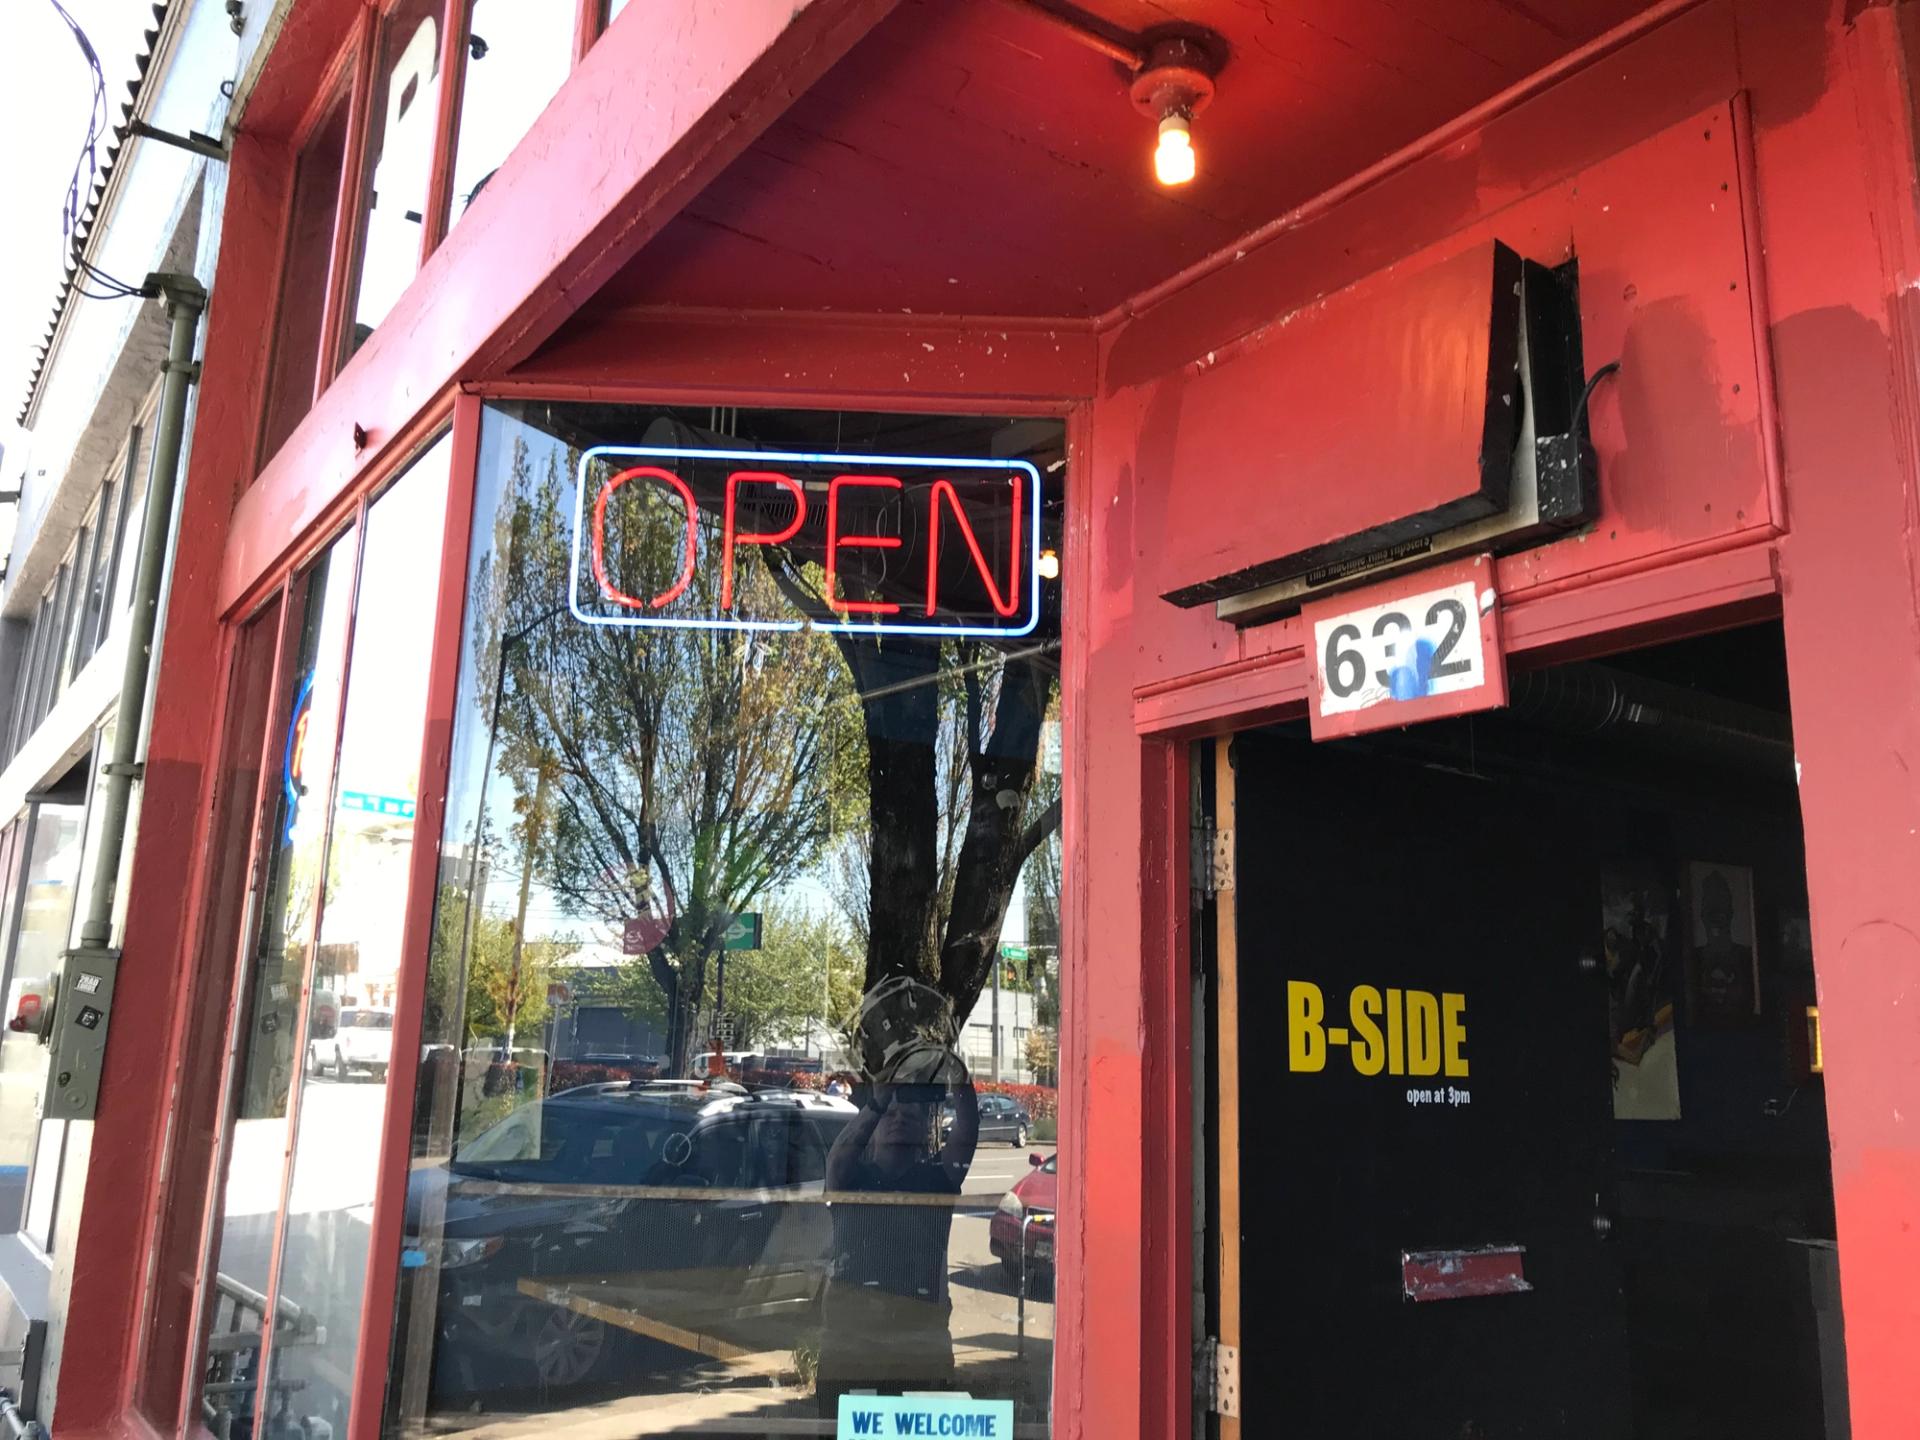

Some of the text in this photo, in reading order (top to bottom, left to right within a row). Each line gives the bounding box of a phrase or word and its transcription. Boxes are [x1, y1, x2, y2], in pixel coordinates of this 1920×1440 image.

[592, 466, 1022, 617] OPEN
[1287, 980, 1469, 1077] B-SIDE
[1407, 1086, 1471, 1107] open at 3pm
[852, 1411, 997, 1437] WE WELCOME
